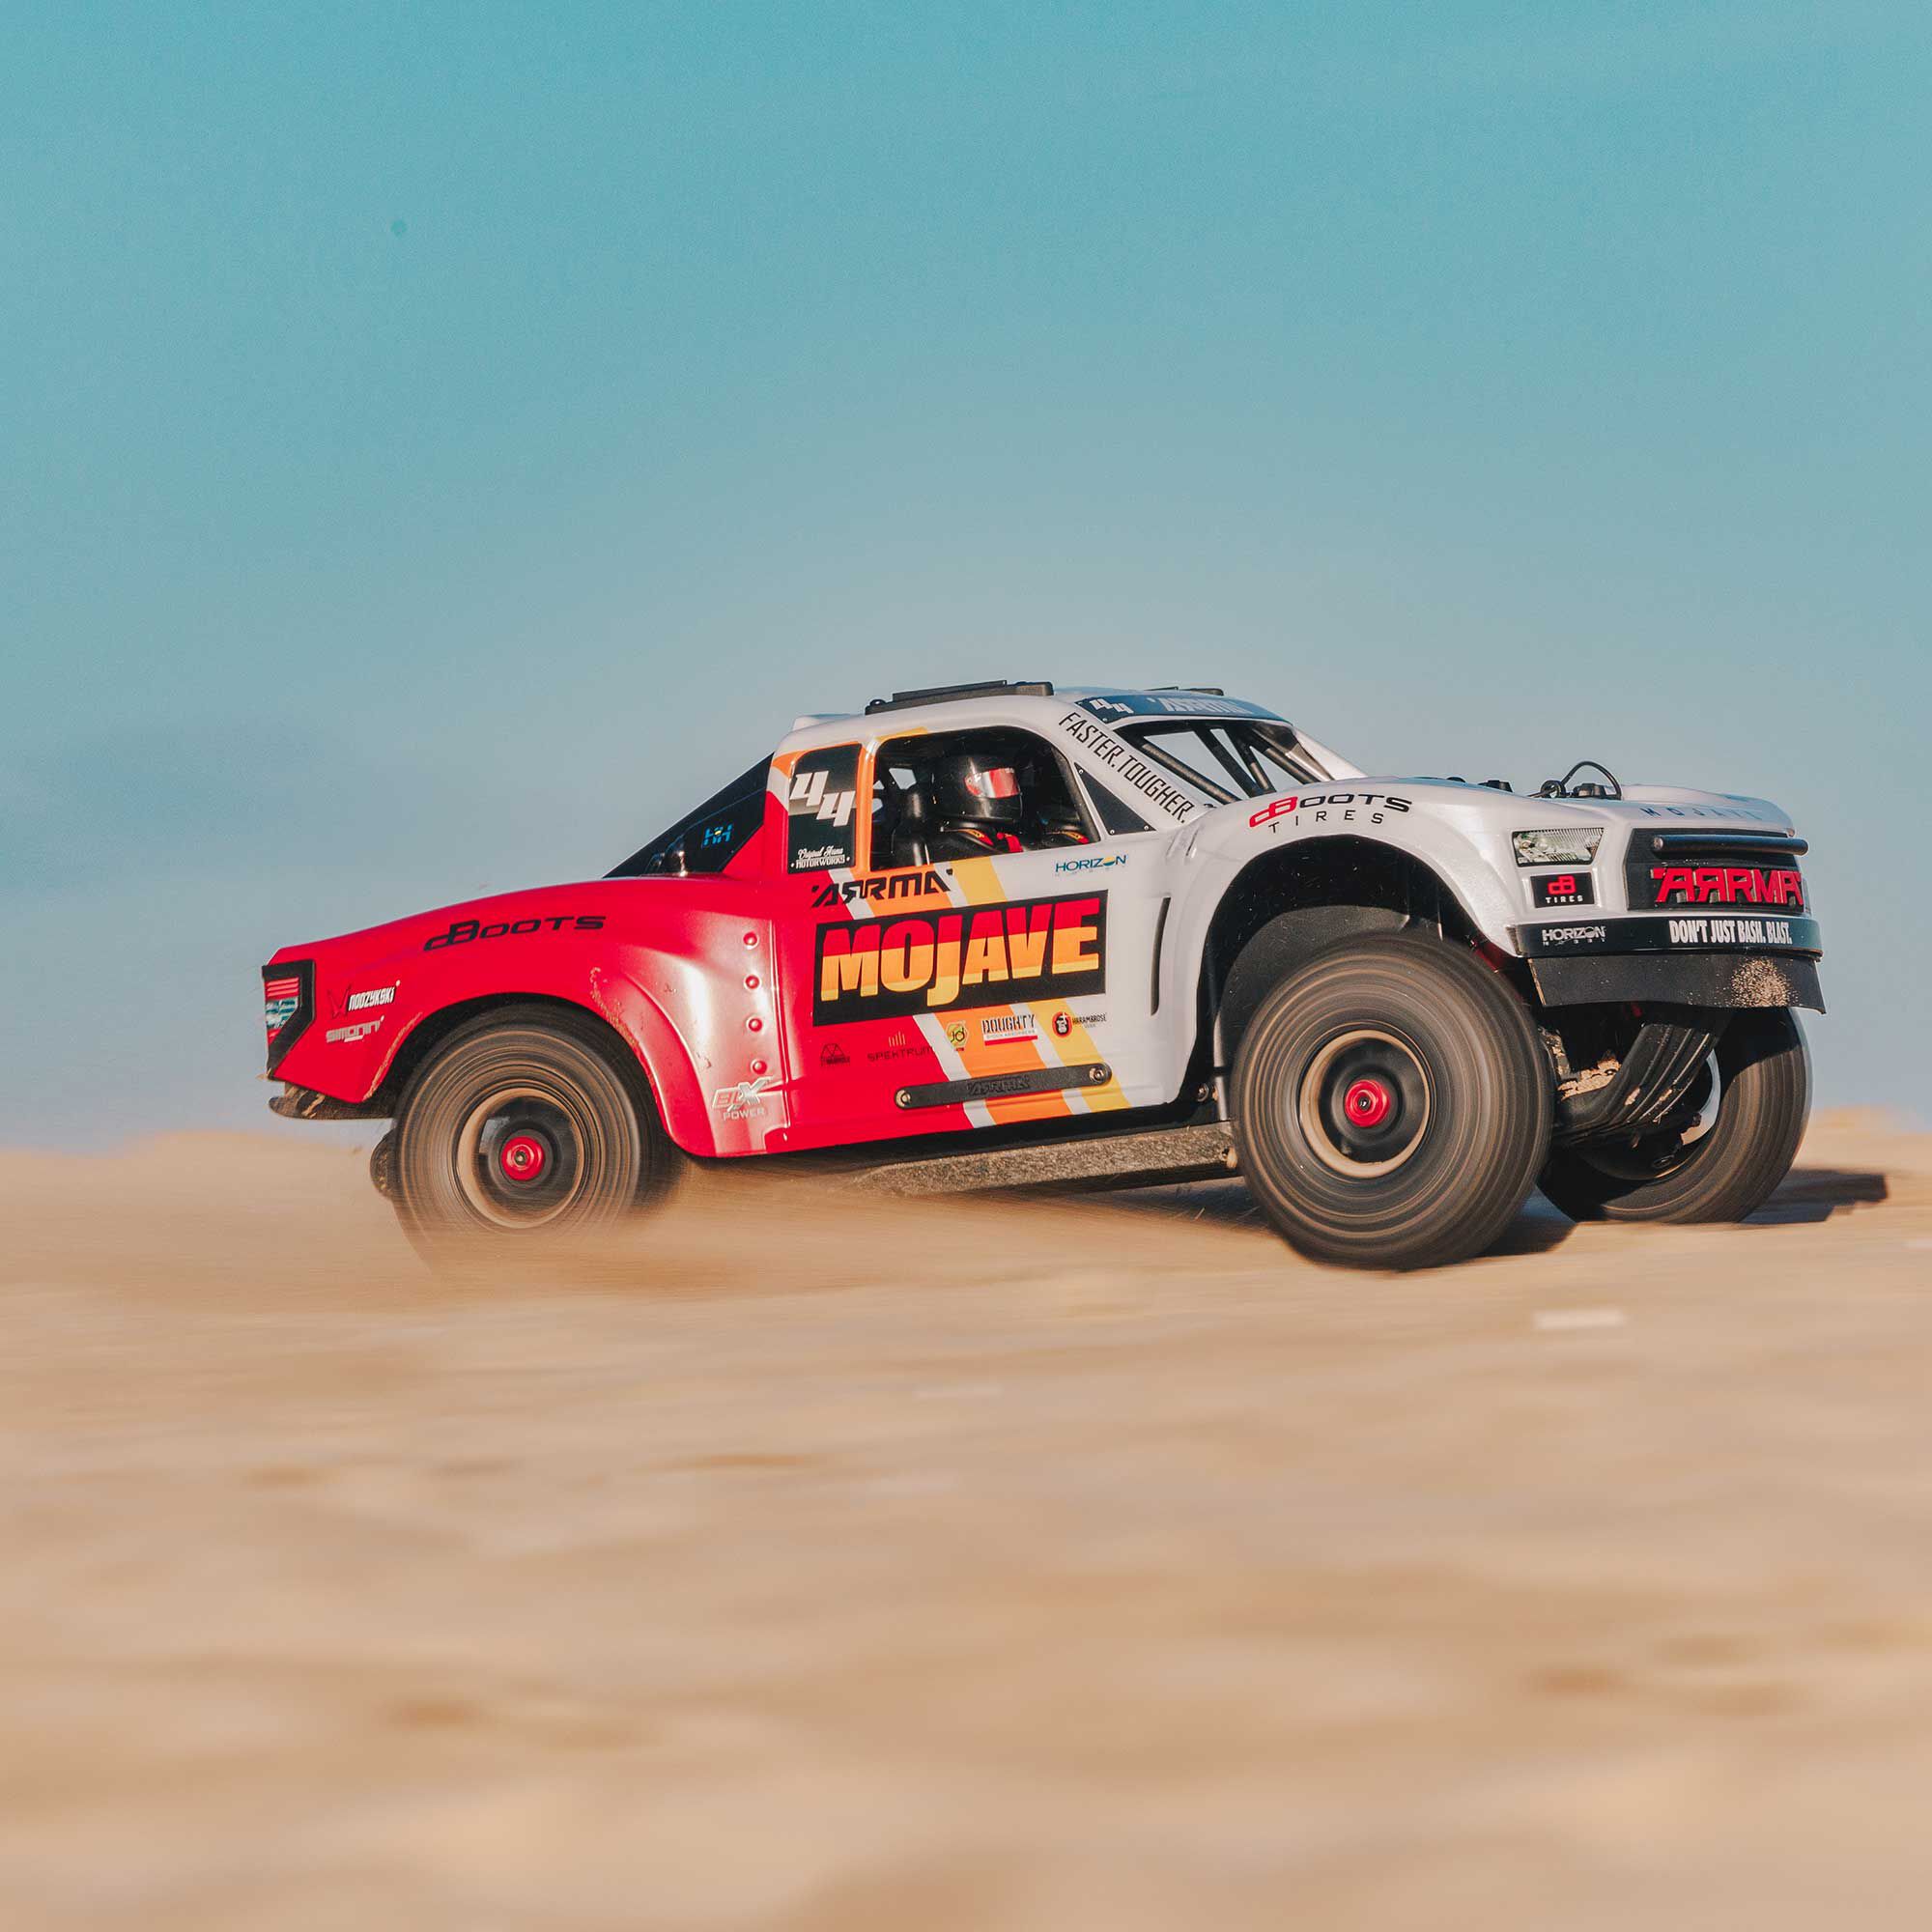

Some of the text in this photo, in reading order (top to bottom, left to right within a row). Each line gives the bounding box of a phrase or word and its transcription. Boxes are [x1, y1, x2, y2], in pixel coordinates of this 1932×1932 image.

[1089, 697, 1134, 714] 44
[1059, 712, 1195, 823] FASTER. TOUGHER.
[789, 770, 856, 827] 44
[1268, 810, 1384, 834] TIRES
[1639, 806, 1763, 821] MOJ
[1055, 854, 1127, 873] HORIZON
[1546, 895, 1583, 904] TIRES
[1542, 925, 1606, 942] HORIZON
[1668, 920, 1793, 945] DON'T JUST BASH. BLAST.
[821, 897, 1100, 1008] MOJAVE
[981, 1013, 1036, 1035] DOUGHTY
[723, 1107, 765, 1122] POWER
